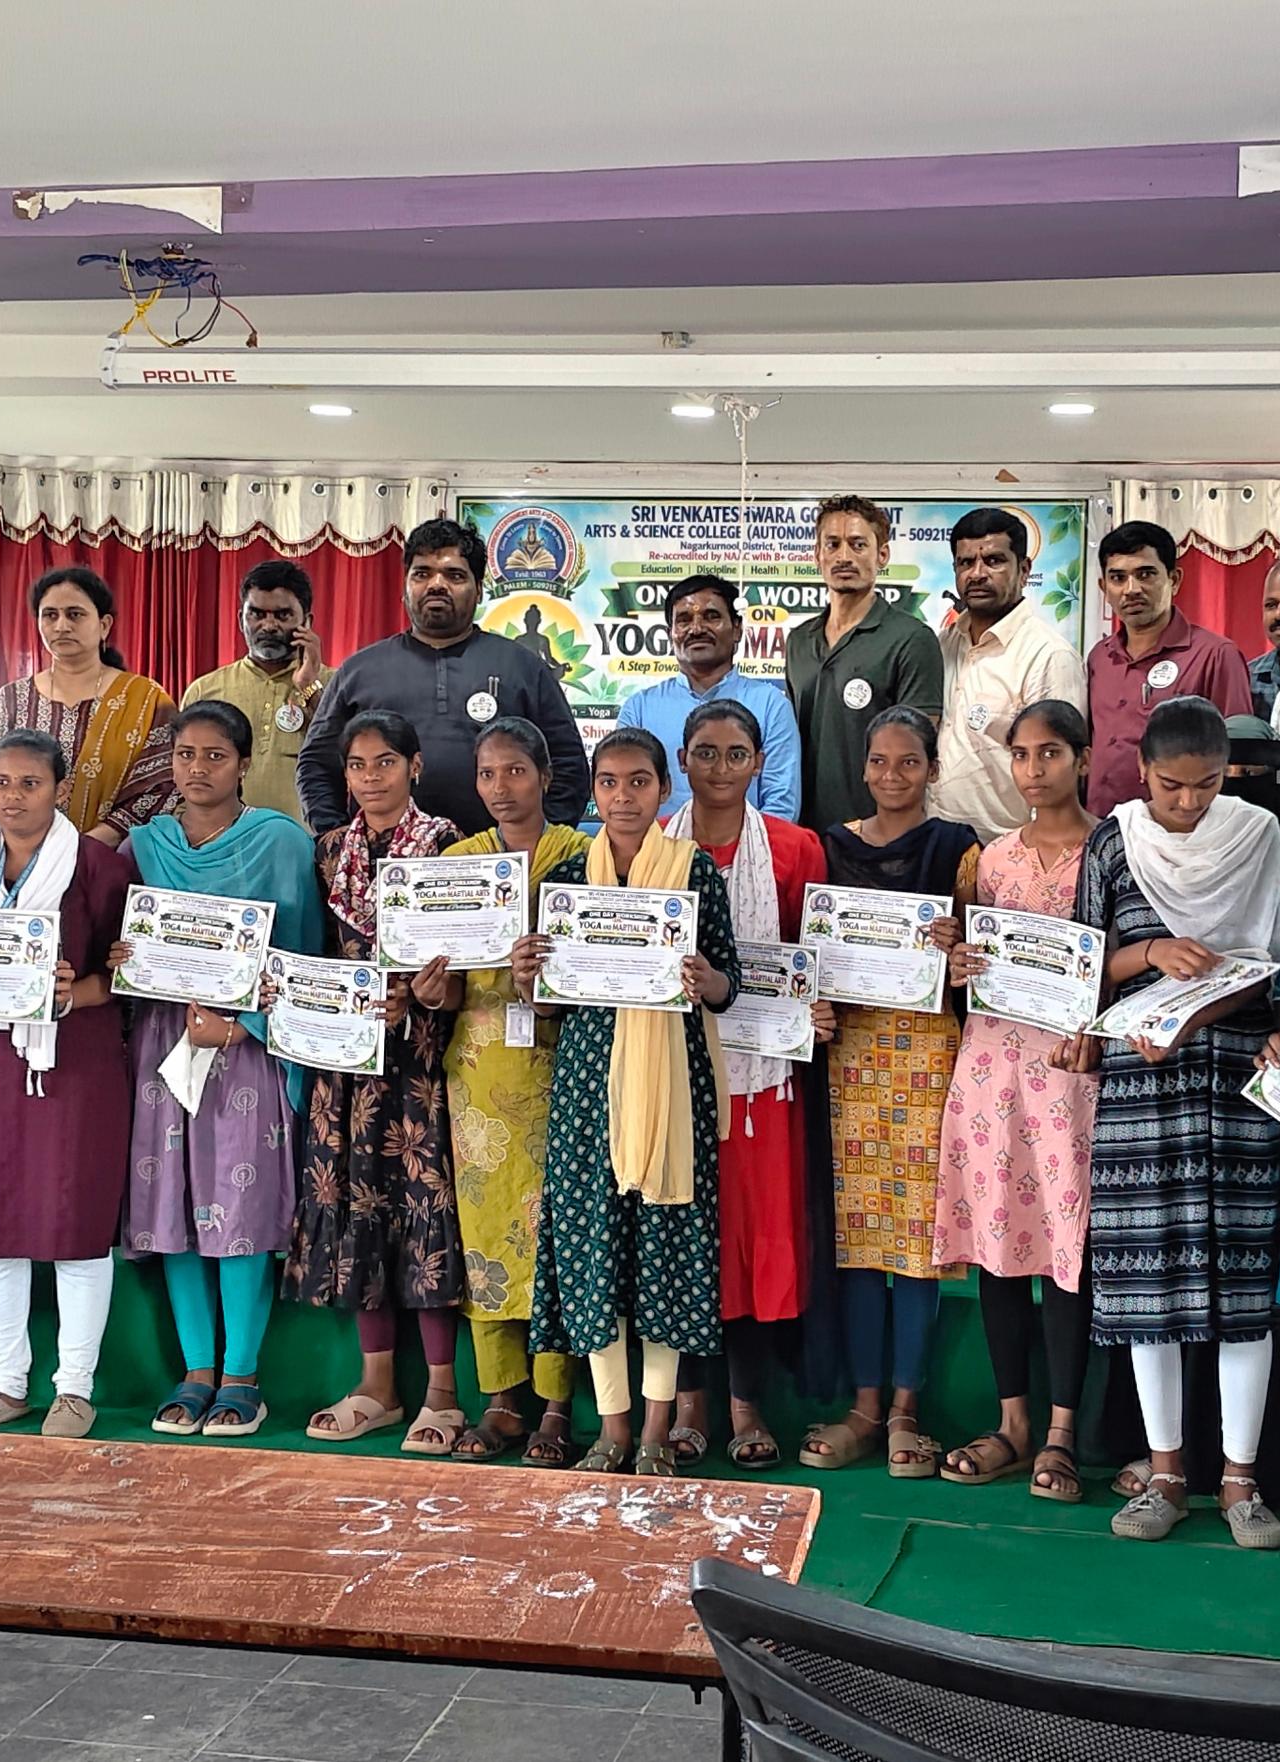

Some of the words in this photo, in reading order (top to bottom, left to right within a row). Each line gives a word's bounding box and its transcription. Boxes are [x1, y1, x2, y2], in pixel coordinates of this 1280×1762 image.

[143, 370, 237, 383] PROLITE
[631, 505, 656, 523] SRI
[584, 524, 617, 538] ARTS
[620, 524, 631, 538] &
[634, 524, 685, 538] SCIENCE
[688, 525, 741, 539] COLLEGE
[680, 541, 740, 552] Nagarkurnool
[742, 541, 776, 552] District,
[649, 551, 708, 561] Re-accredited
[710, 551, 722, 563] by
[753, 551, 772, 562] with
[774, 552, 785, 562] B+
[787, 552, 814, 562] Grade
[640, 564, 683, 575] Education
[696, 564, 737, 576] Discipline
[750, 565, 780, 576] Health
[634, 584, 669, 606] ON
[751, 608, 776, 621] ON
[595, 623, 672, 657] YOG
[618, 660, 625, 671] A
[627, 660, 651, 673] Step
[588, 706, 611, 719] Yoga
[415, 890, 437, 899] YOGA
[160, 922, 181, 932] YOGA
[191, 926, 217, 937] MARTIAL
[218, 931, 232, 939] ARTS
[579, 921, 602, 930] YOGA
[612, 924, 640, 932] MARTIAL
[642, 925, 657, 933] ARTS
[839, 920, 859, 930] YOGA
[1004, 942, 1026, 953] YOGA
